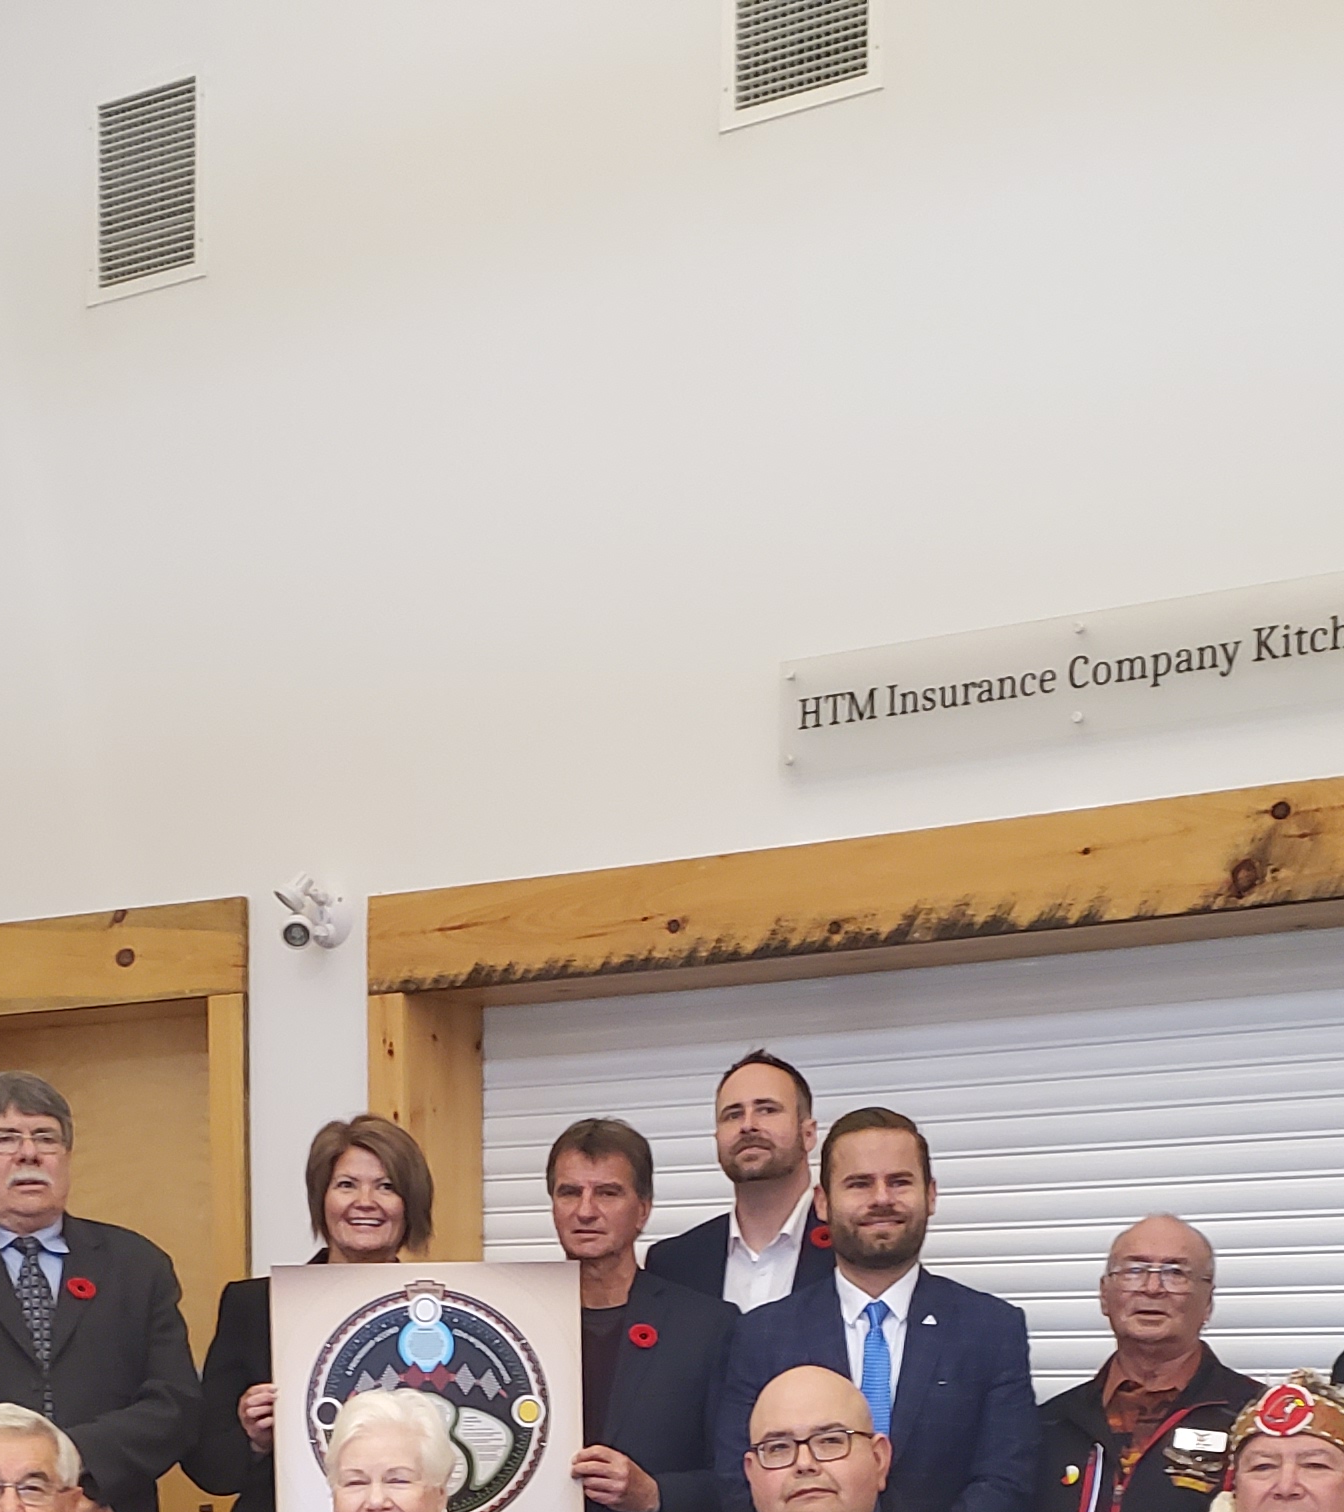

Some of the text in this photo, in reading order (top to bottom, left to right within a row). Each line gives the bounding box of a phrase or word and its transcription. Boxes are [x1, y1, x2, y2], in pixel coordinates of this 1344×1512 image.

[796, 686, 880, 732] HTM
[884, 668, 1058, 718] Insurance
[1067, 639, 1243, 690] Company
